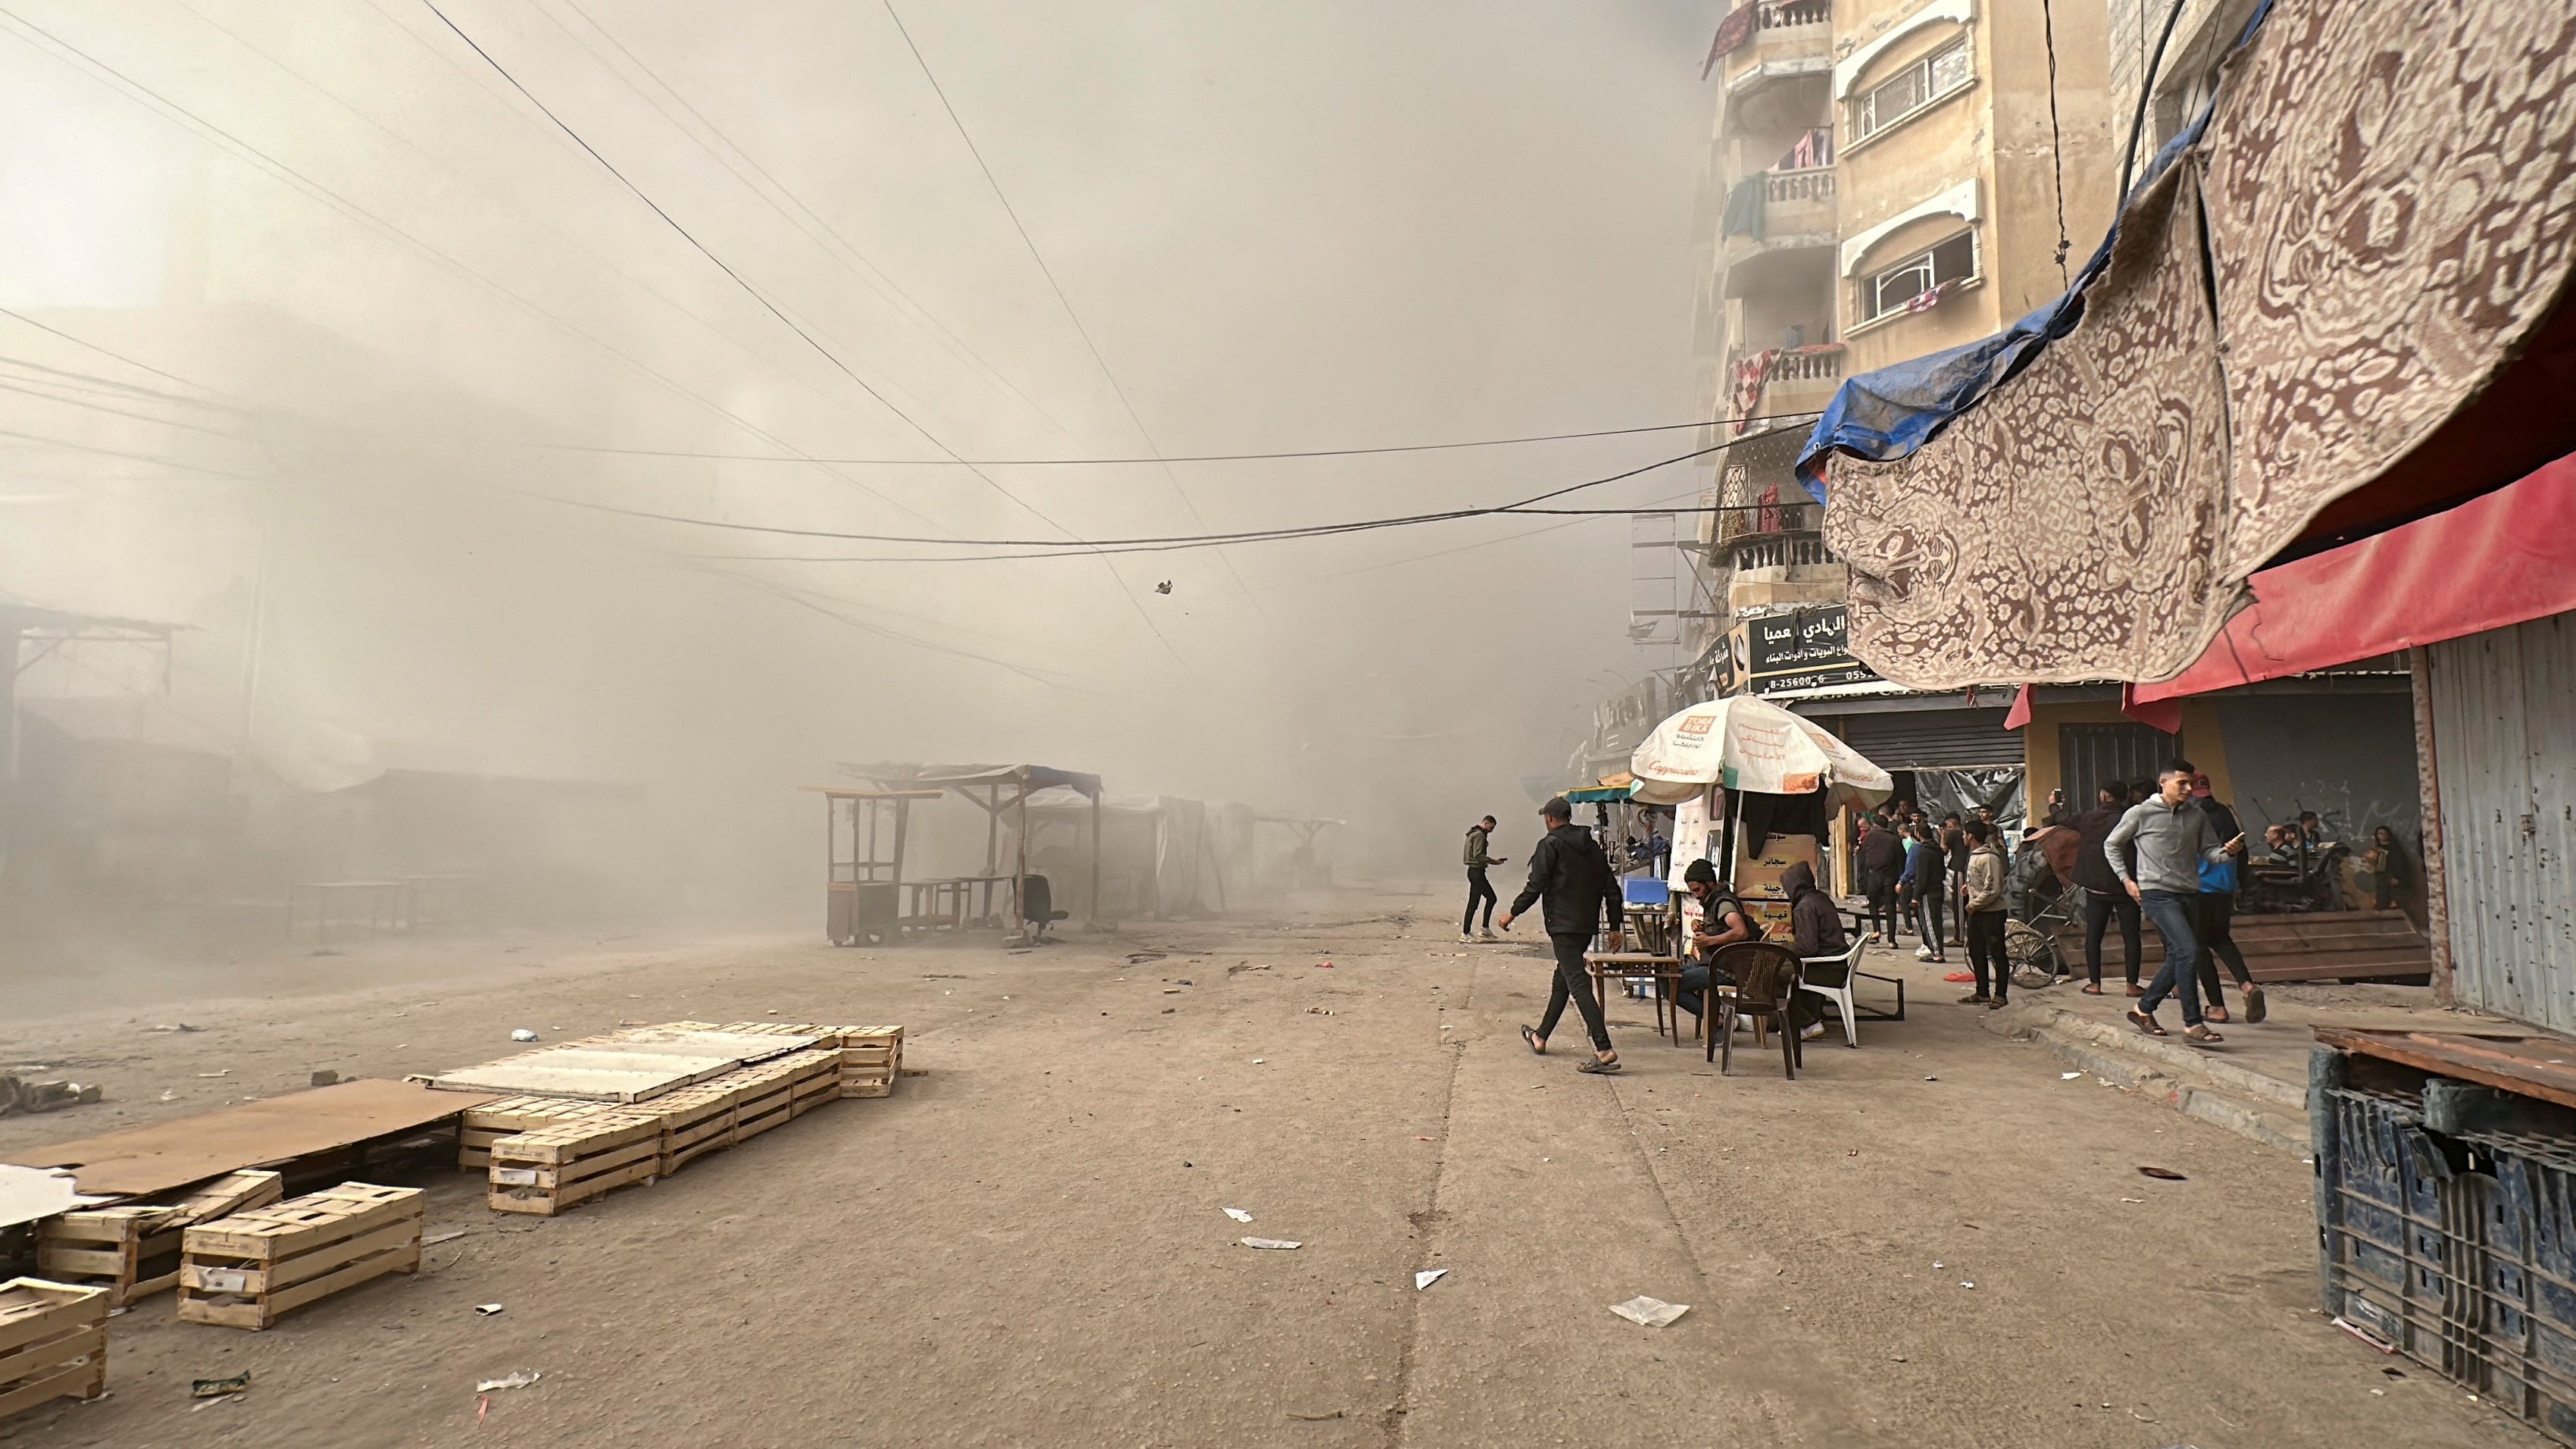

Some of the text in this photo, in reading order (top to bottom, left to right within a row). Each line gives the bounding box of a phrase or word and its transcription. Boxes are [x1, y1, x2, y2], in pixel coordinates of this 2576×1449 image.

[1803, 615, 1845, 643] الهادي
[1689, 716, 1714, 725] TORA
[1683, 724, 1709, 733] BIKA
[1649, 760, 1699, 775] Cappuccino
[1763, 857, 1786, 867] سجائر
[1764, 910, 1787, 920] قهوة
